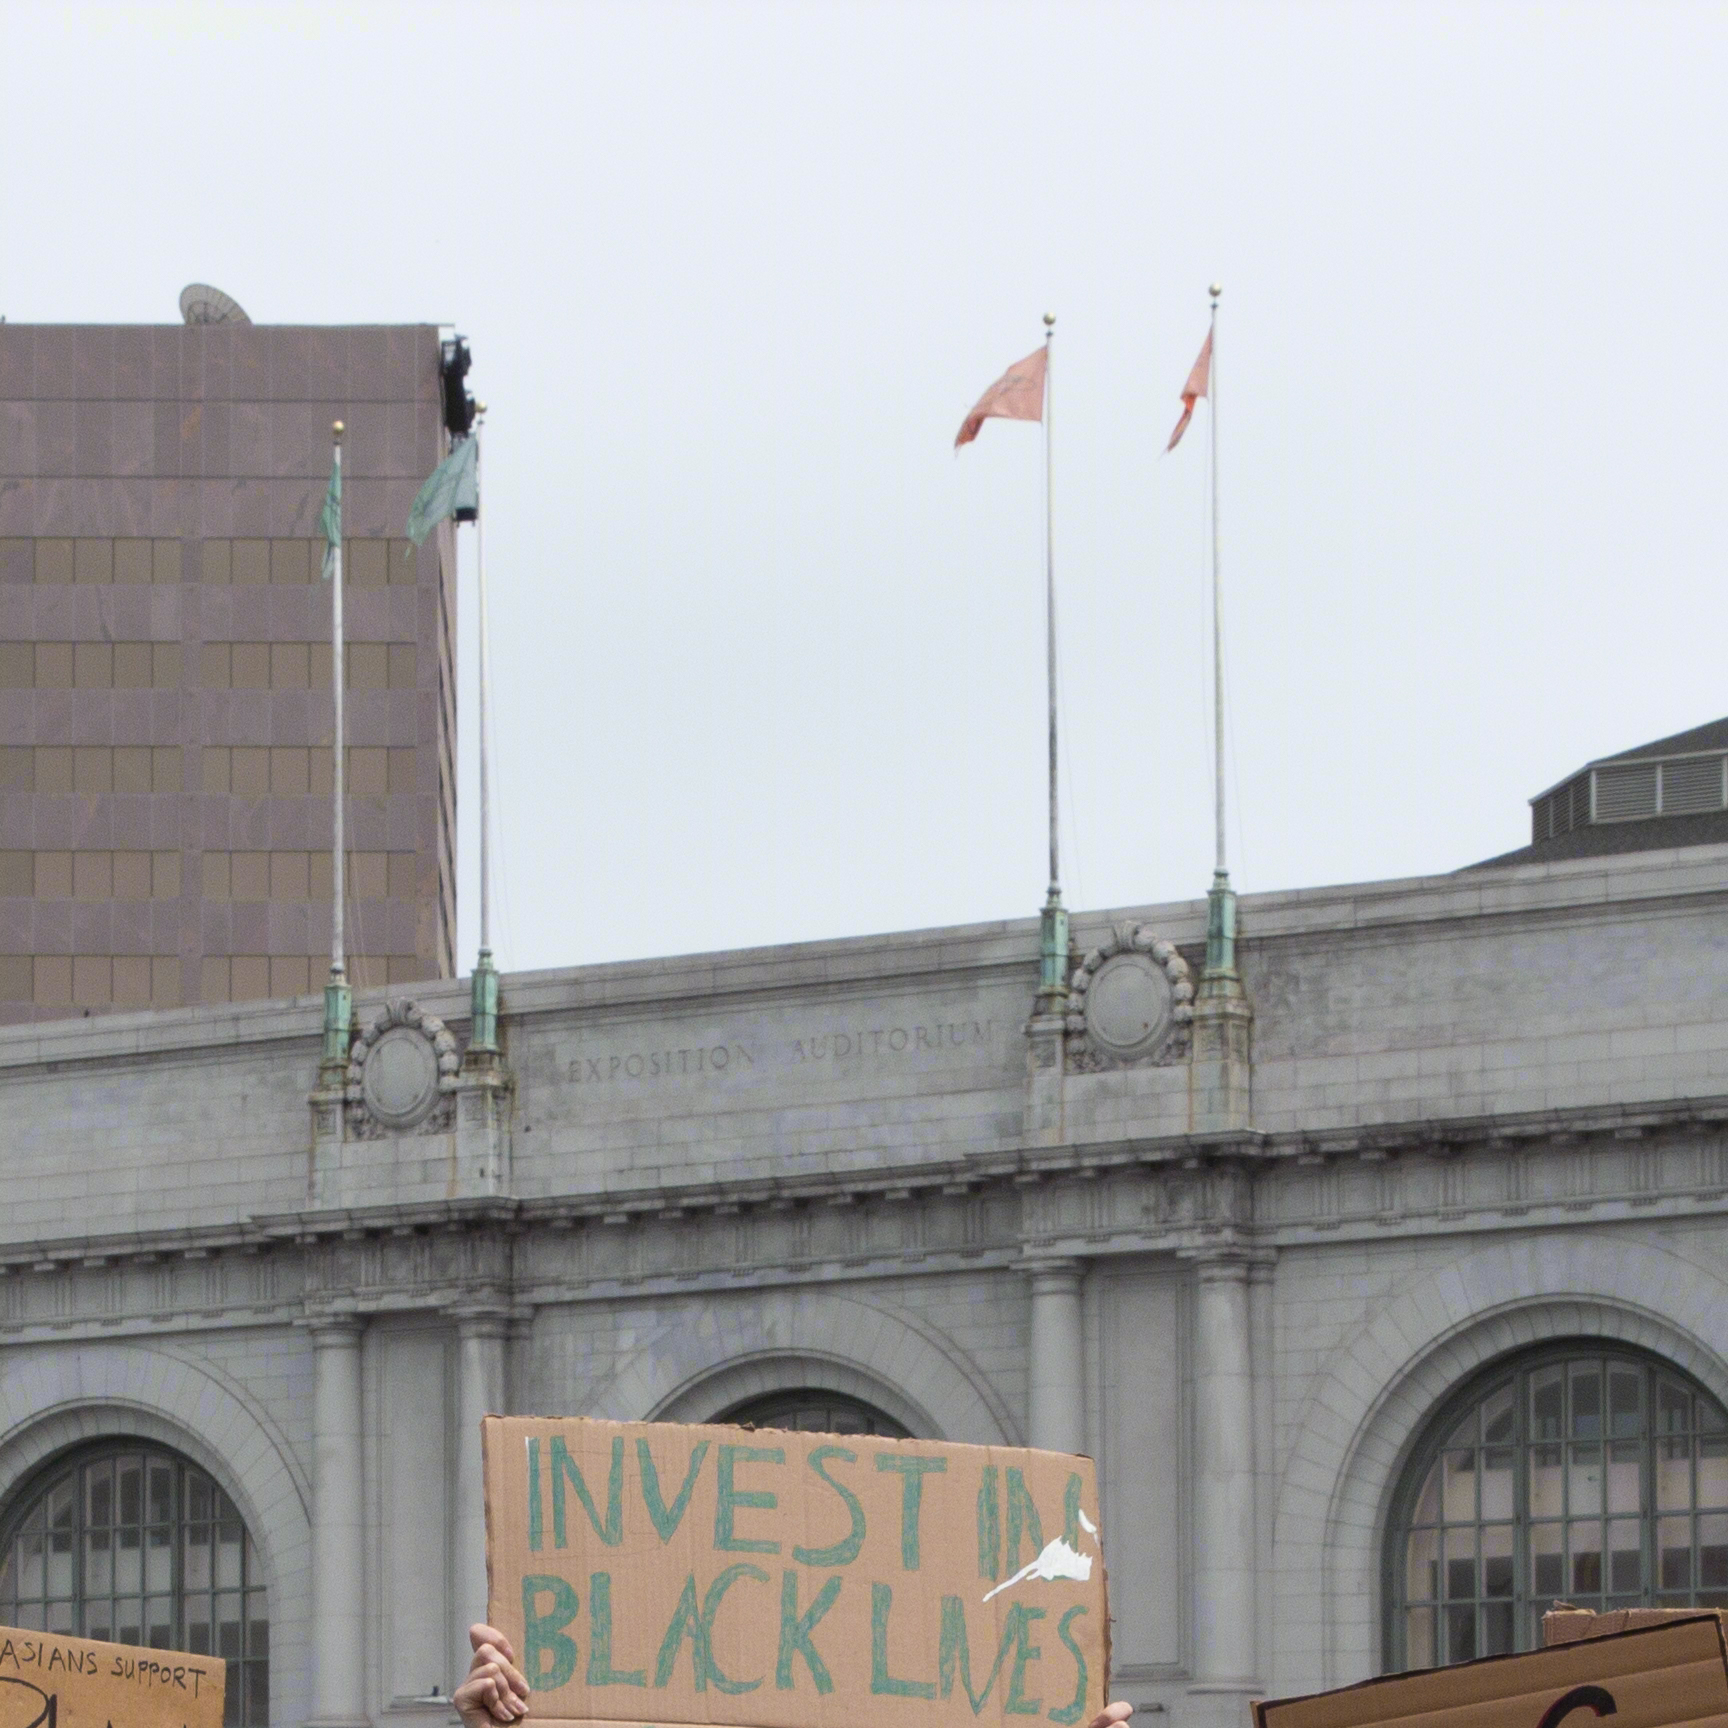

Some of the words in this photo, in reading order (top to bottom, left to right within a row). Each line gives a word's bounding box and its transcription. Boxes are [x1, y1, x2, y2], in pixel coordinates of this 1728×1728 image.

[568, 1043, 755, 1085] EXPOSITION
[791, 1019, 993, 1064] AUDITORIUM
[525, 1434, 948, 1571] INVEST
[976, 1464, 1084, 1582] IN
[111, 1656, 207, 1699] SUPPORT
[521, 1561, 843, 1696] BLACK
[871, 1581, 1091, 1727] LIVES
